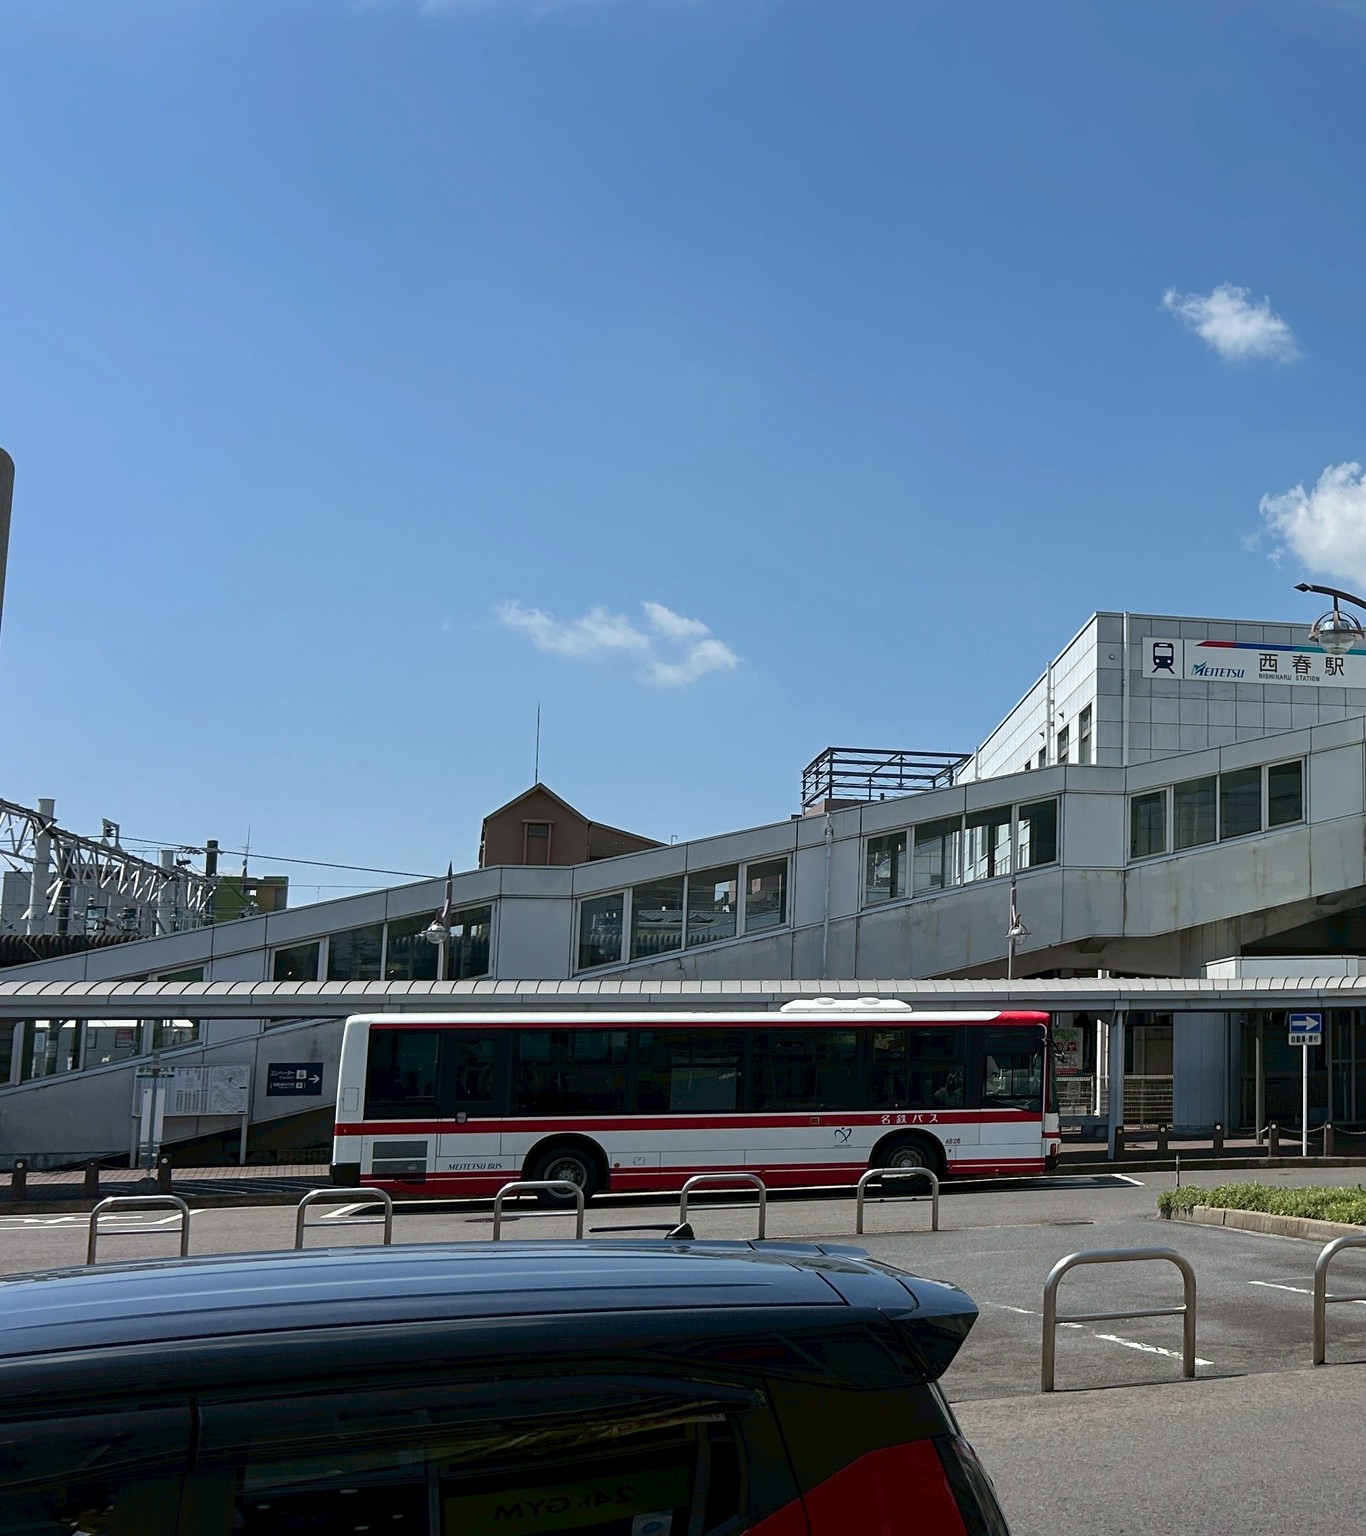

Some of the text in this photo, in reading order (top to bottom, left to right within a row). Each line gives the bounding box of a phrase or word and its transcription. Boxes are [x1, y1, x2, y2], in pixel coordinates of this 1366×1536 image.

[1191, 660, 1245, 678] MEITETSU
[1258, 653, 1345, 677] 西春駅
[1258, 673, 1321, 682] NISHIHARU STATION
[881, 1114, 939, 1124] 名鉄バス
